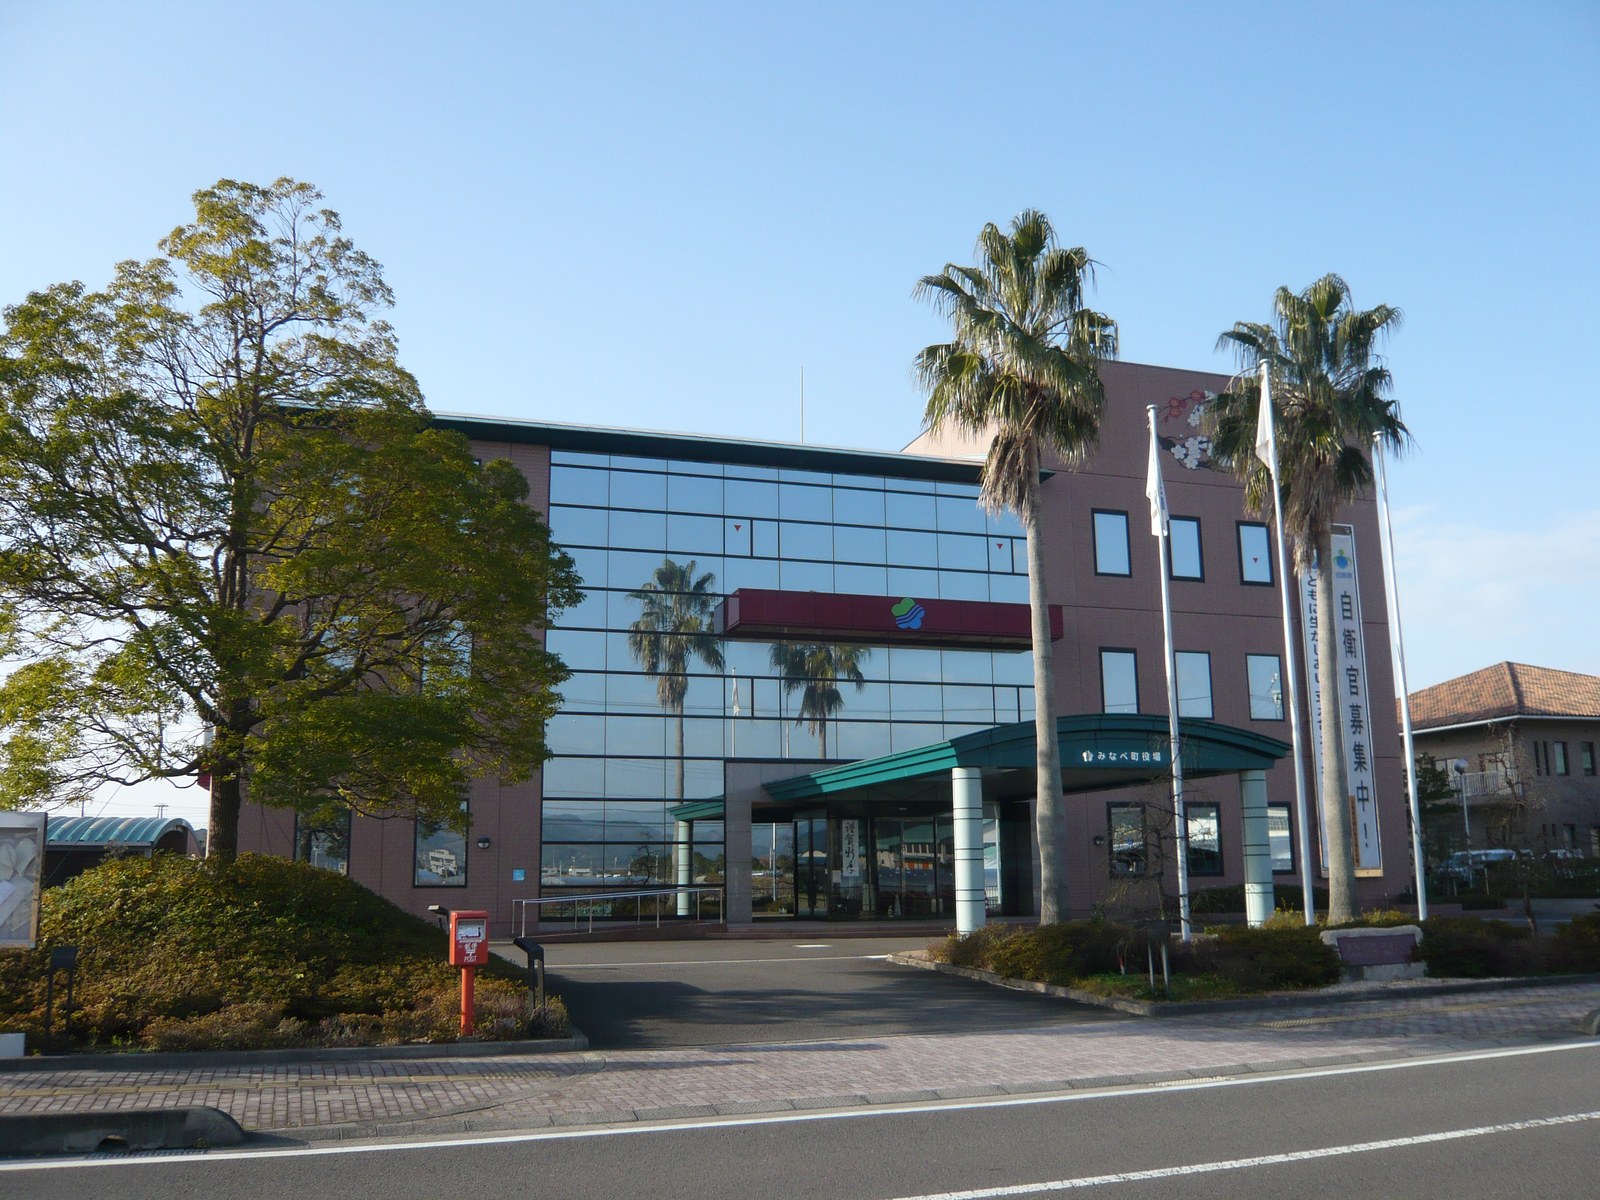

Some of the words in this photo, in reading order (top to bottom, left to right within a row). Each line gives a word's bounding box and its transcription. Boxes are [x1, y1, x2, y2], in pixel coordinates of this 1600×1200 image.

[1097, 751, 1161, 761] みなべ町役場
